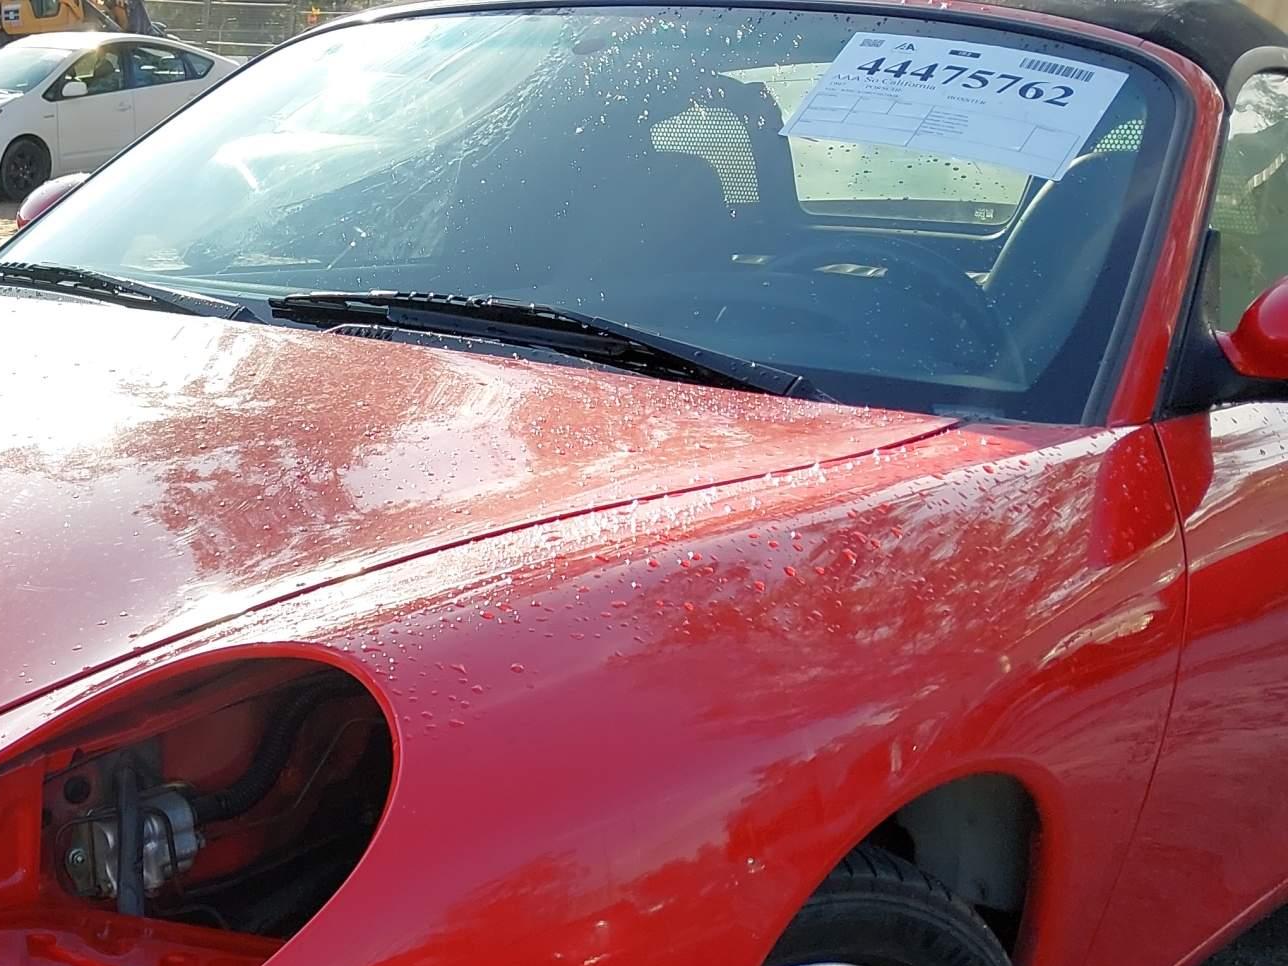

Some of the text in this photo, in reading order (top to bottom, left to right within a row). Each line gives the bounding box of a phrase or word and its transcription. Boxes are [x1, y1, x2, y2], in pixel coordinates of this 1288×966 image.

[832, 73, 860, 81] AAA
[881, 77, 936, 91] California
[857, 57, 1074, 107] 44475762
